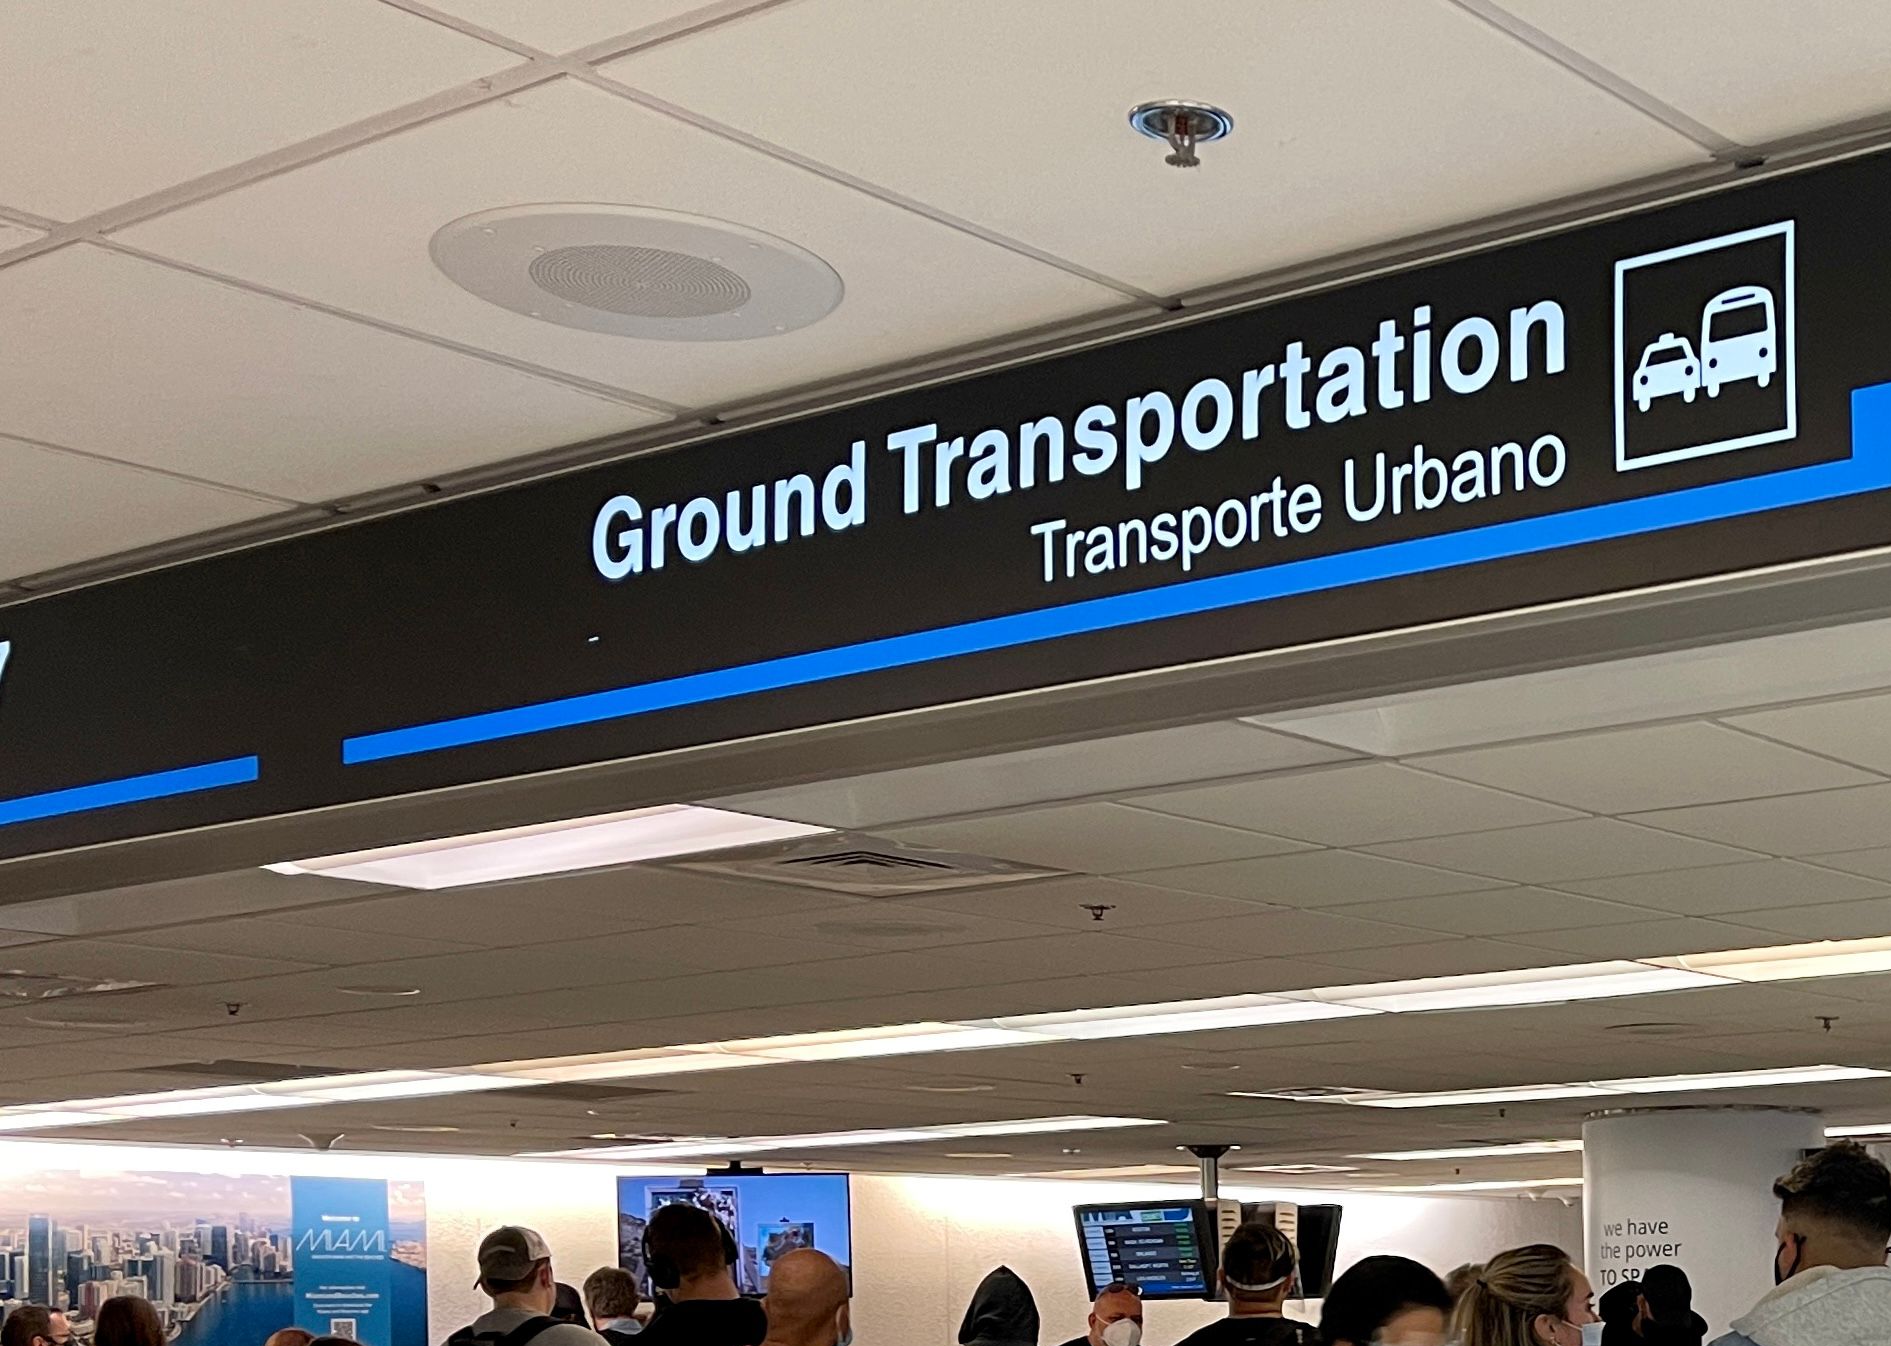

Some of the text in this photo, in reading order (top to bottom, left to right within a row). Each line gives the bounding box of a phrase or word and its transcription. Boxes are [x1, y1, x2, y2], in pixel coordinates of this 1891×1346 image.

[591, 299, 1567, 581] Ground Transportation
[1029, 433, 1567, 584] Transporte Urbano
[1603, 1218, 1669, 1237] we have
[295, 1228, 386, 1252] MIAMI
[1600, 1242, 1682, 1263] the power
[1600, 1268, 1617, 1286] TO
